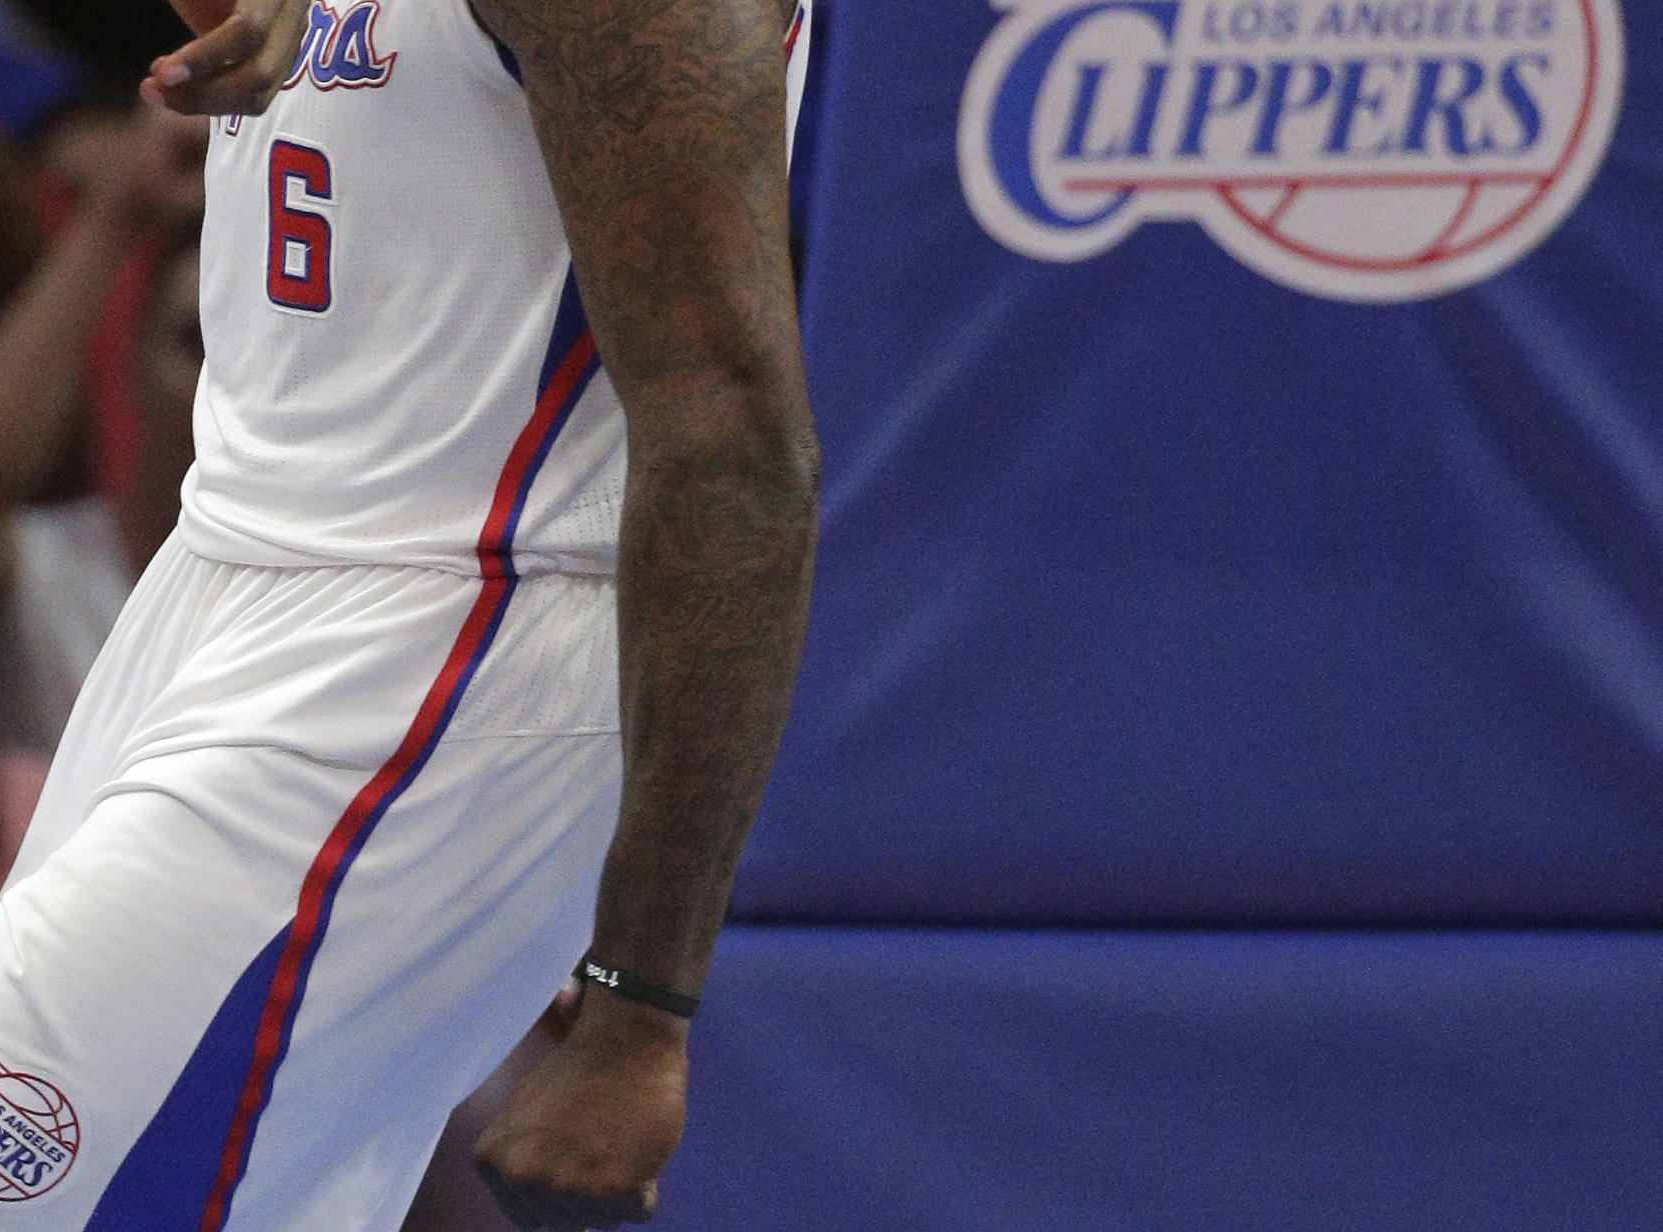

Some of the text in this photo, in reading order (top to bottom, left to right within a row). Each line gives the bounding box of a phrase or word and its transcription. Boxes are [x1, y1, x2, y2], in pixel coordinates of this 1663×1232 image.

[1200, 0, 1299, 43] LOS
[266, 138, 333, 313] 6
[2, 1115, 67, 1164] ANGELES
